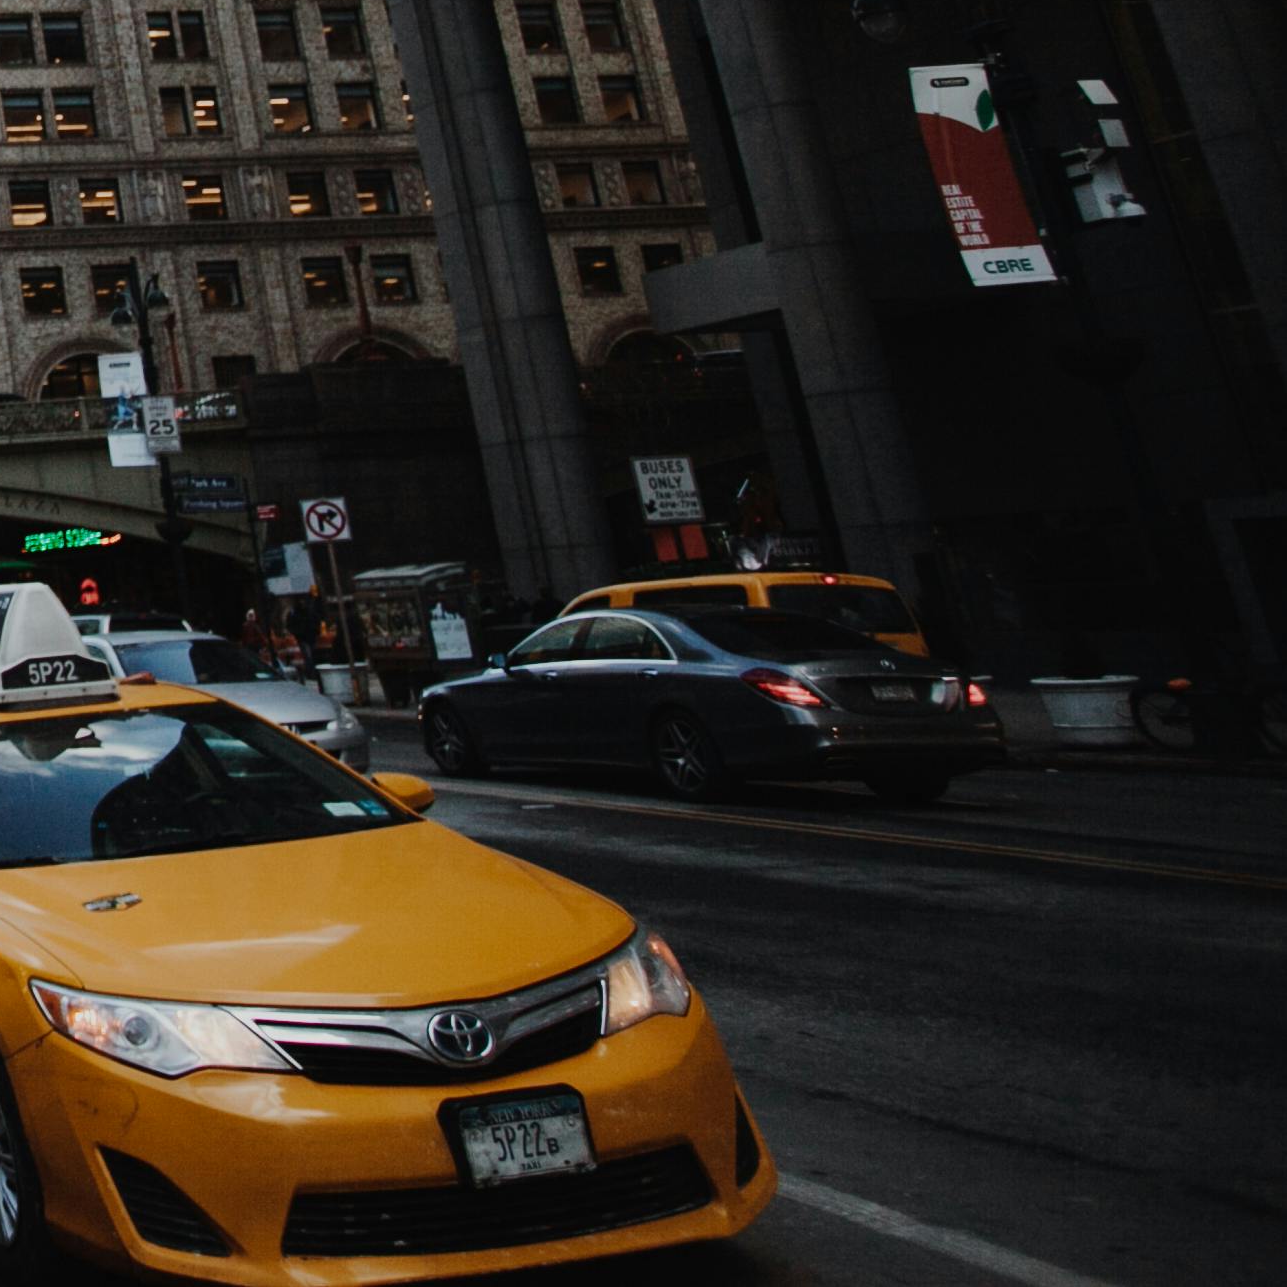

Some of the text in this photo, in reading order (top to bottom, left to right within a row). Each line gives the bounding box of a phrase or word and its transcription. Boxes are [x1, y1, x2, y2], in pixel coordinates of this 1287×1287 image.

[940, 184, 963, 196] REAL
[953, 221, 984, 234] OF THE
[957, 233, 991, 246] WORLD
[983, 258, 1035, 274] CBRE
[149, 419, 175, 435] 25
[640, 460, 684, 474] BUSES
[648, 476, 682, 489] ONLY
[28, 659, 79, 684] 5P22
[489, 1109, 514, 1125] NEW
[521, 1160, 542, 1170] TAXI
